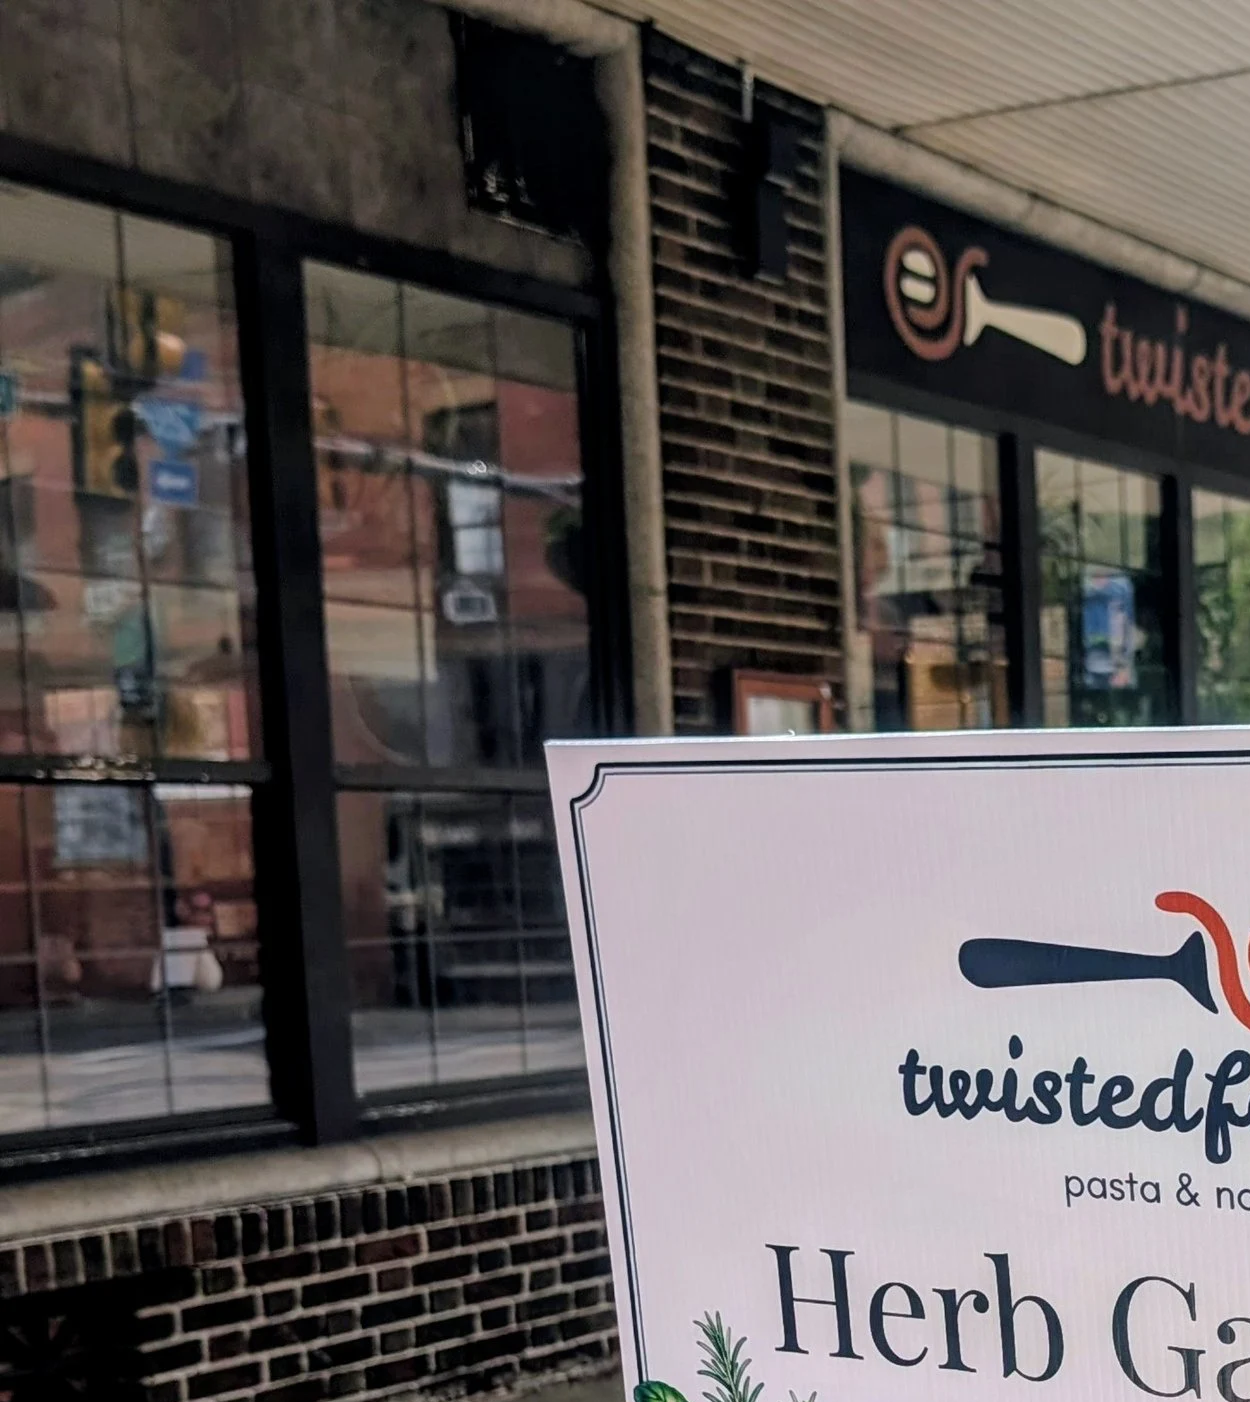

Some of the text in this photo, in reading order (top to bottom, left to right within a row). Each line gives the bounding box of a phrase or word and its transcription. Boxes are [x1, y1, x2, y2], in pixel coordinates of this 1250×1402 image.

[1064, 1172, 1161, 1208] pasta
[1175, 1172, 1201, 1207] &
[764, 1243, 1066, 1383] Herb
